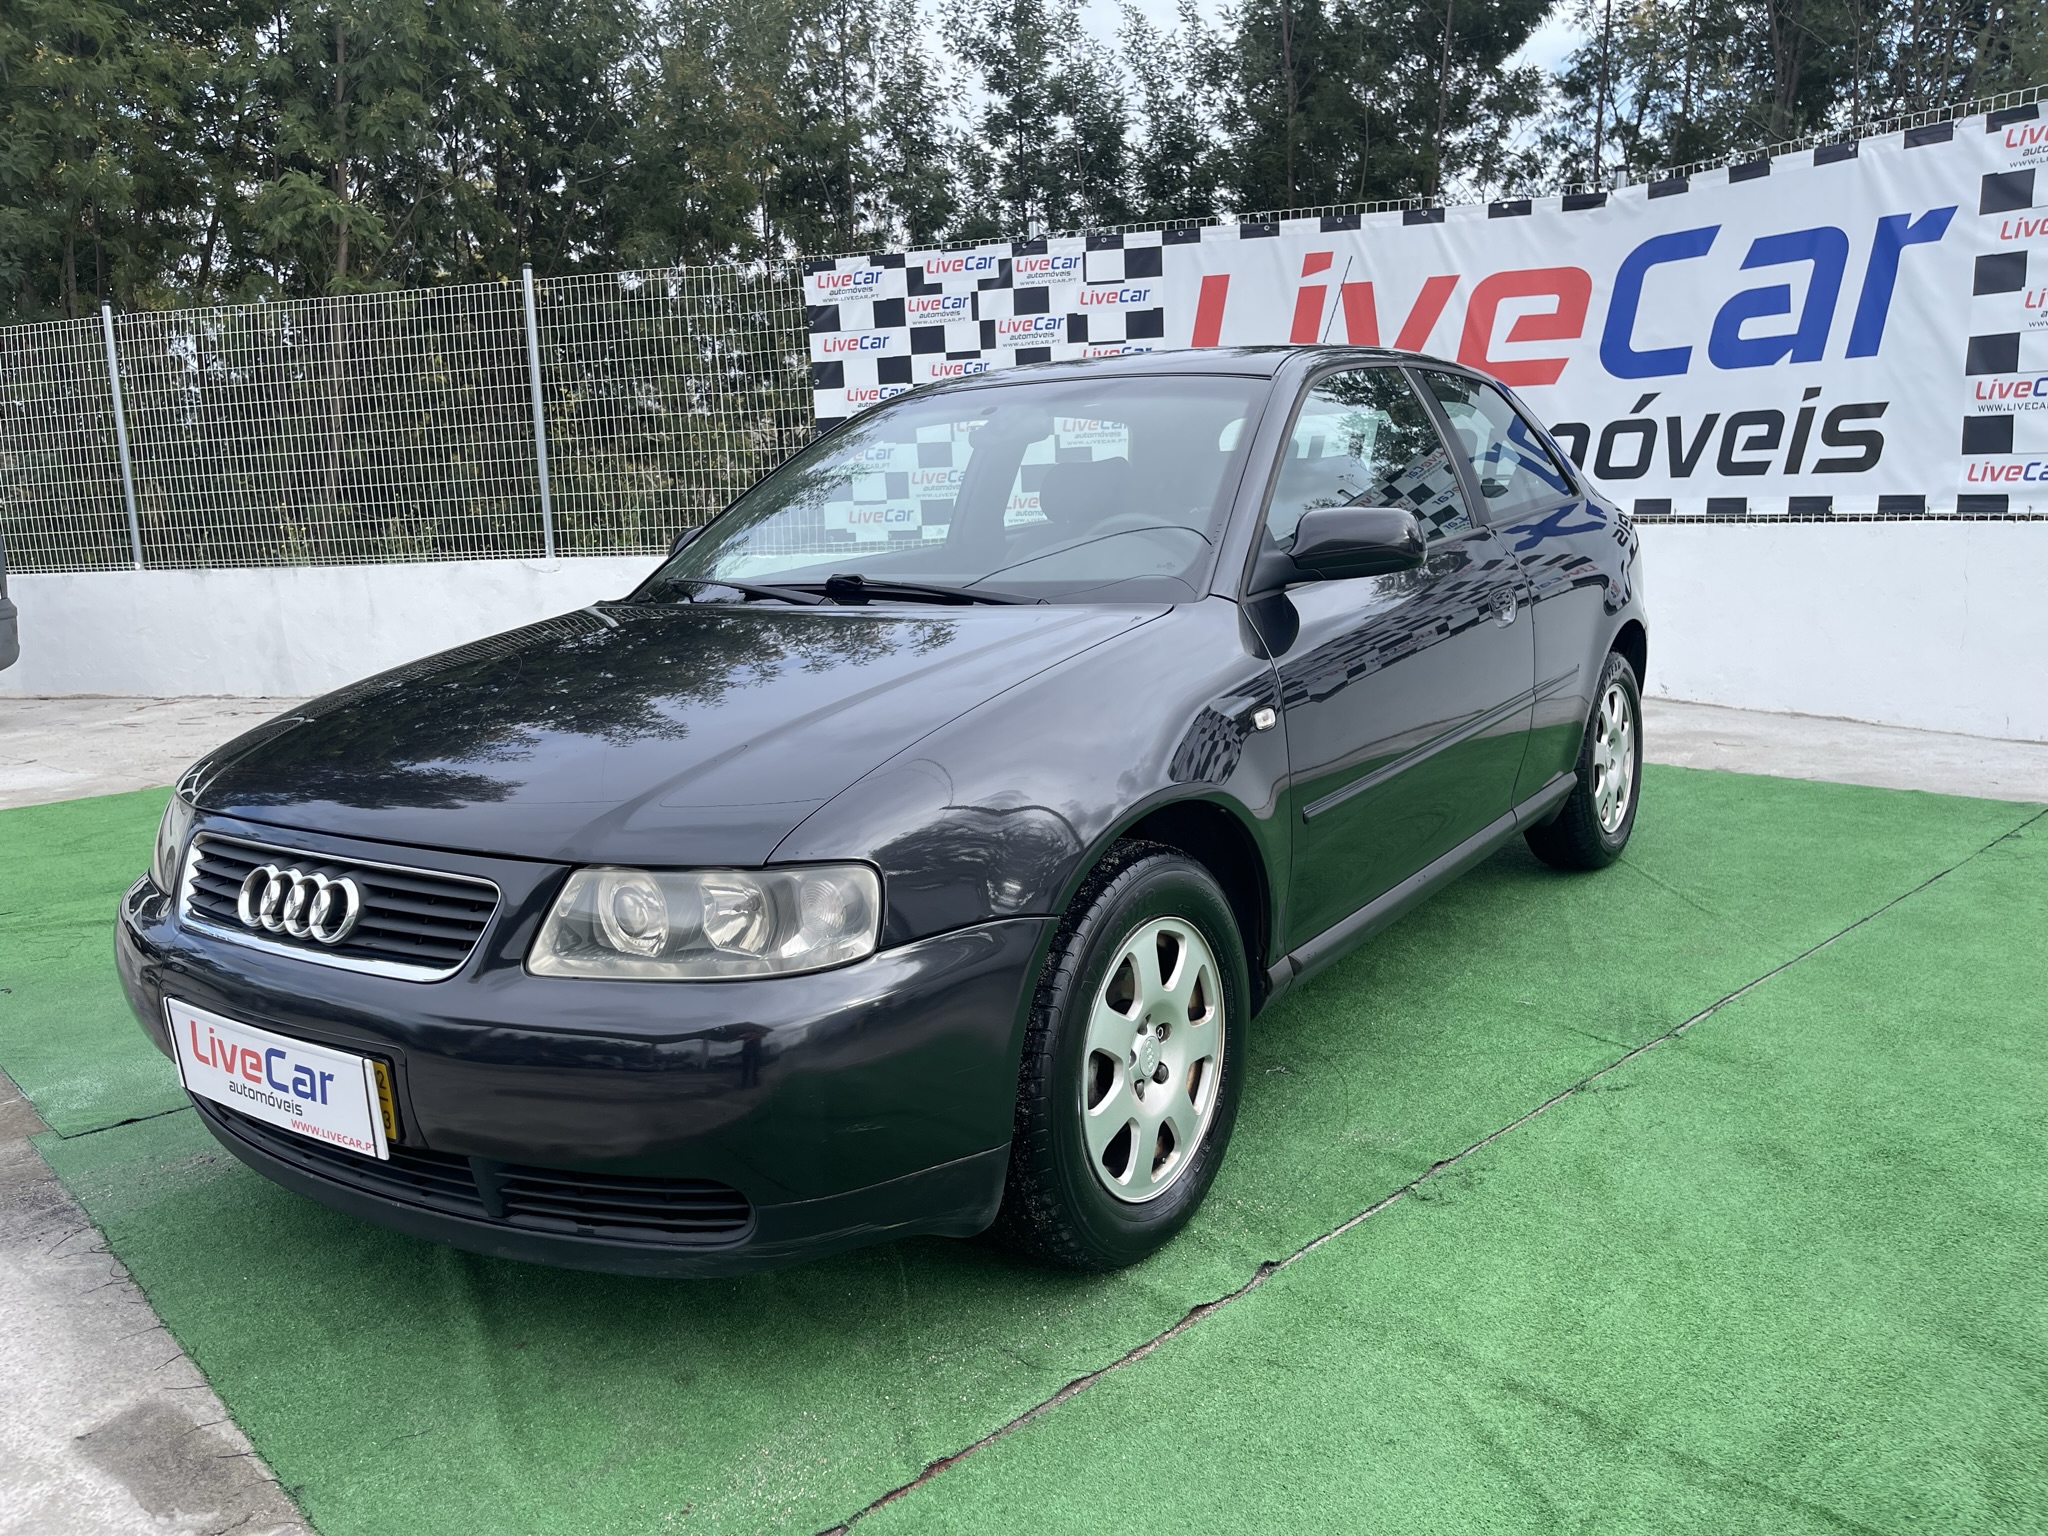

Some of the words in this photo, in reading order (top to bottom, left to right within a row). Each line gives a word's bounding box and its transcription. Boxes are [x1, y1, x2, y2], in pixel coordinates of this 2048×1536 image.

[2005, 124, 2048, 148] Liv
[926, 256, 996, 275] LiveCar
[1016, 255, 1081, 273] LiveCar
[817, 270, 883, 289] LiveCar
[1026, 270, 1071, 279] automóveis
[829, 286, 873, 296] automóveis
[1080, 288, 1151, 306] LiveCar
[908, 296, 969, 312] LiveCar
[919, 310, 961, 319] automóveis
[998, 316, 1065, 334] LiveCar
[823, 336, 890, 353] LiveCar
[1009, 331, 1055, 341] automóveis
[931, 361, 990, 377] LiveCar
[1977, 401, 2048, 413] WWW.LIVECA
[849, 508, 914, 524] LiveCar
[190, 1020, 335, 1106] LiveCar
[228, 1079, 303, 1117] automóveis
